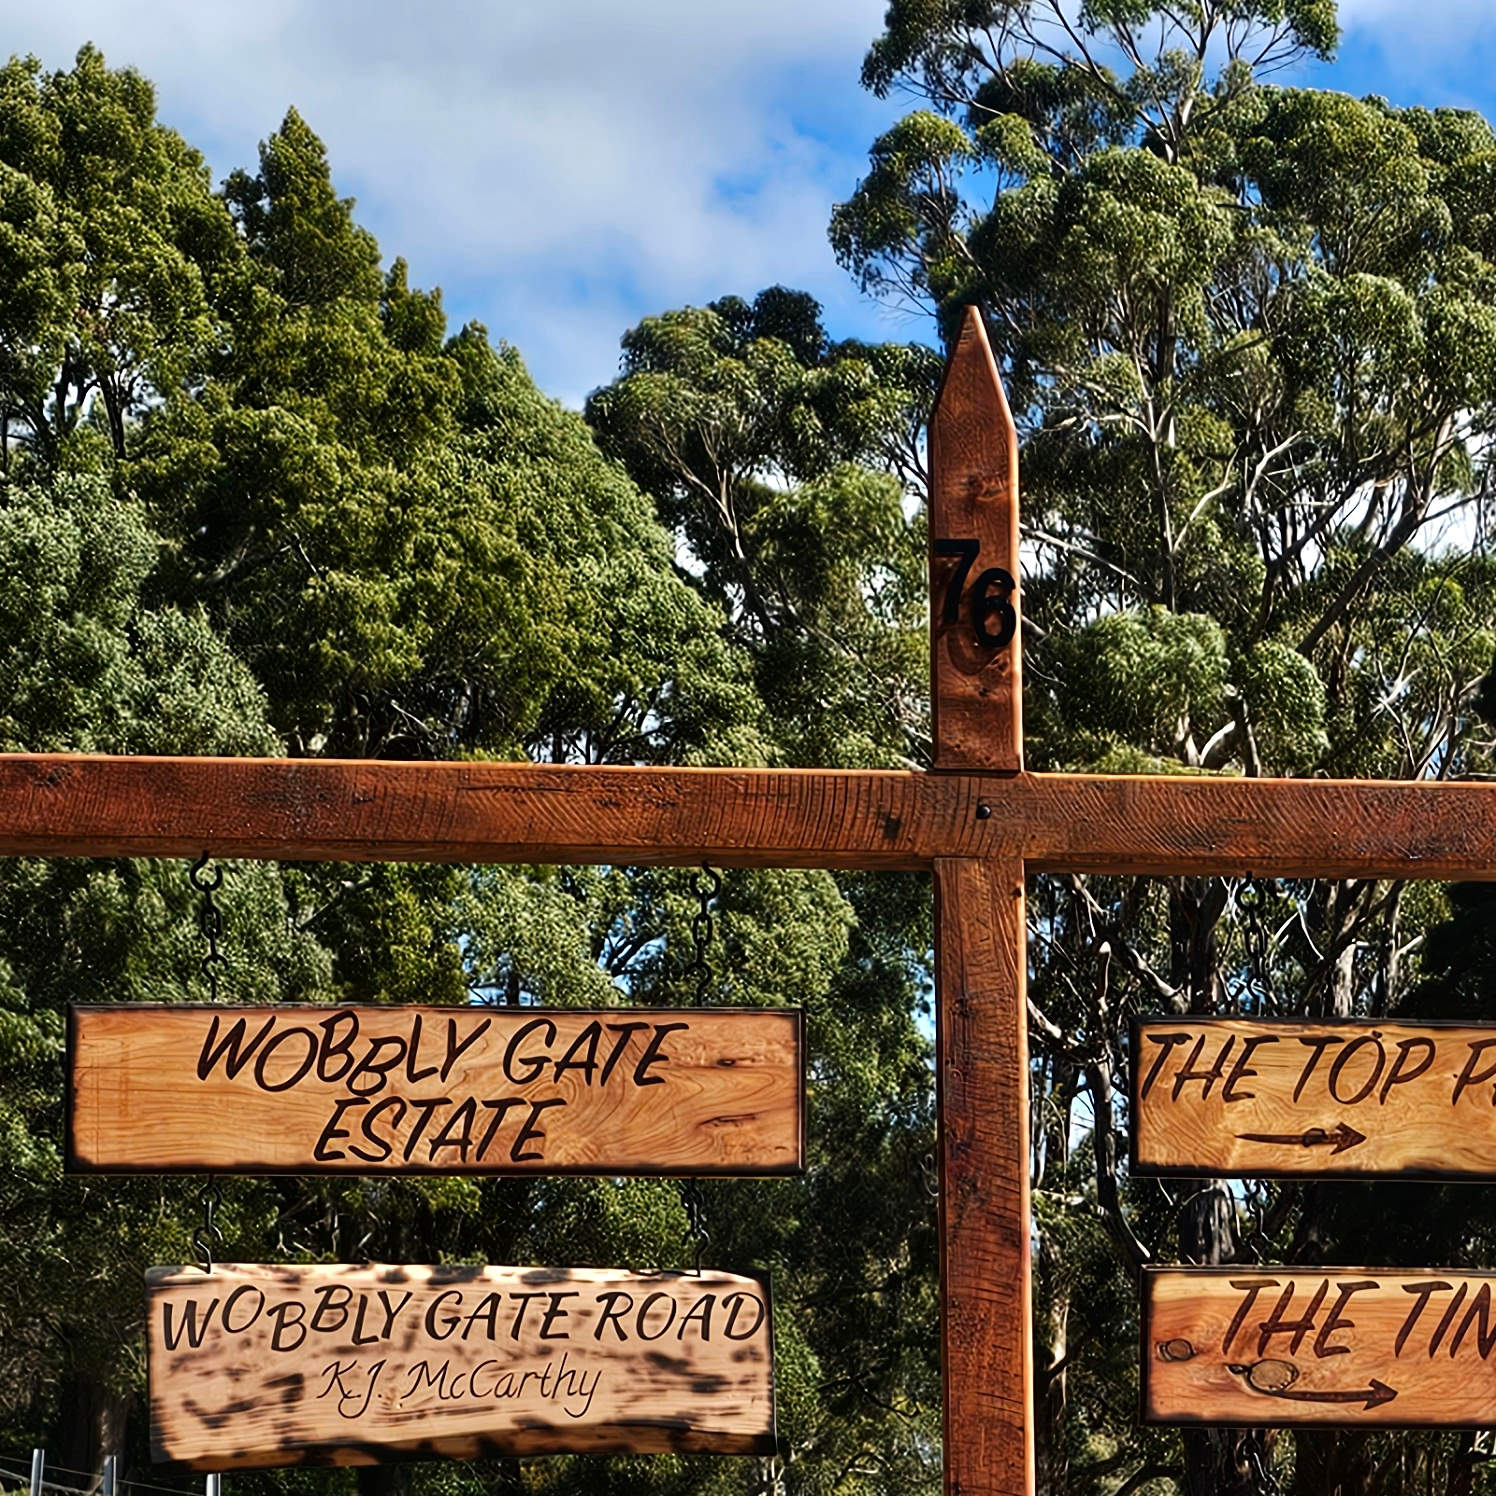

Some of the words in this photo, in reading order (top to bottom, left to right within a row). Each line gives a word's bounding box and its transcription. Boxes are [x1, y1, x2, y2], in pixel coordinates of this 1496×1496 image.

[934, 538, 1017, 648] 76
[197, 1010, 492, 1098] WOBBLY
[503, 1017, 691, 1087] GATE
[1139, 1033, 1279, 1103] THE
[1292, 1034, 1437, 1105] TOP
[313, 1095, 567, 1163] ESTATE
[162, 1283, 414, 1353] WOBBLY
[424, 1290, 581, 1343] GATE
[593, 1292, 767, 1343] ROAD
[1221, 1278, 1381, 1361] THE
[400, 1352, 602, 1418] McCarthy
